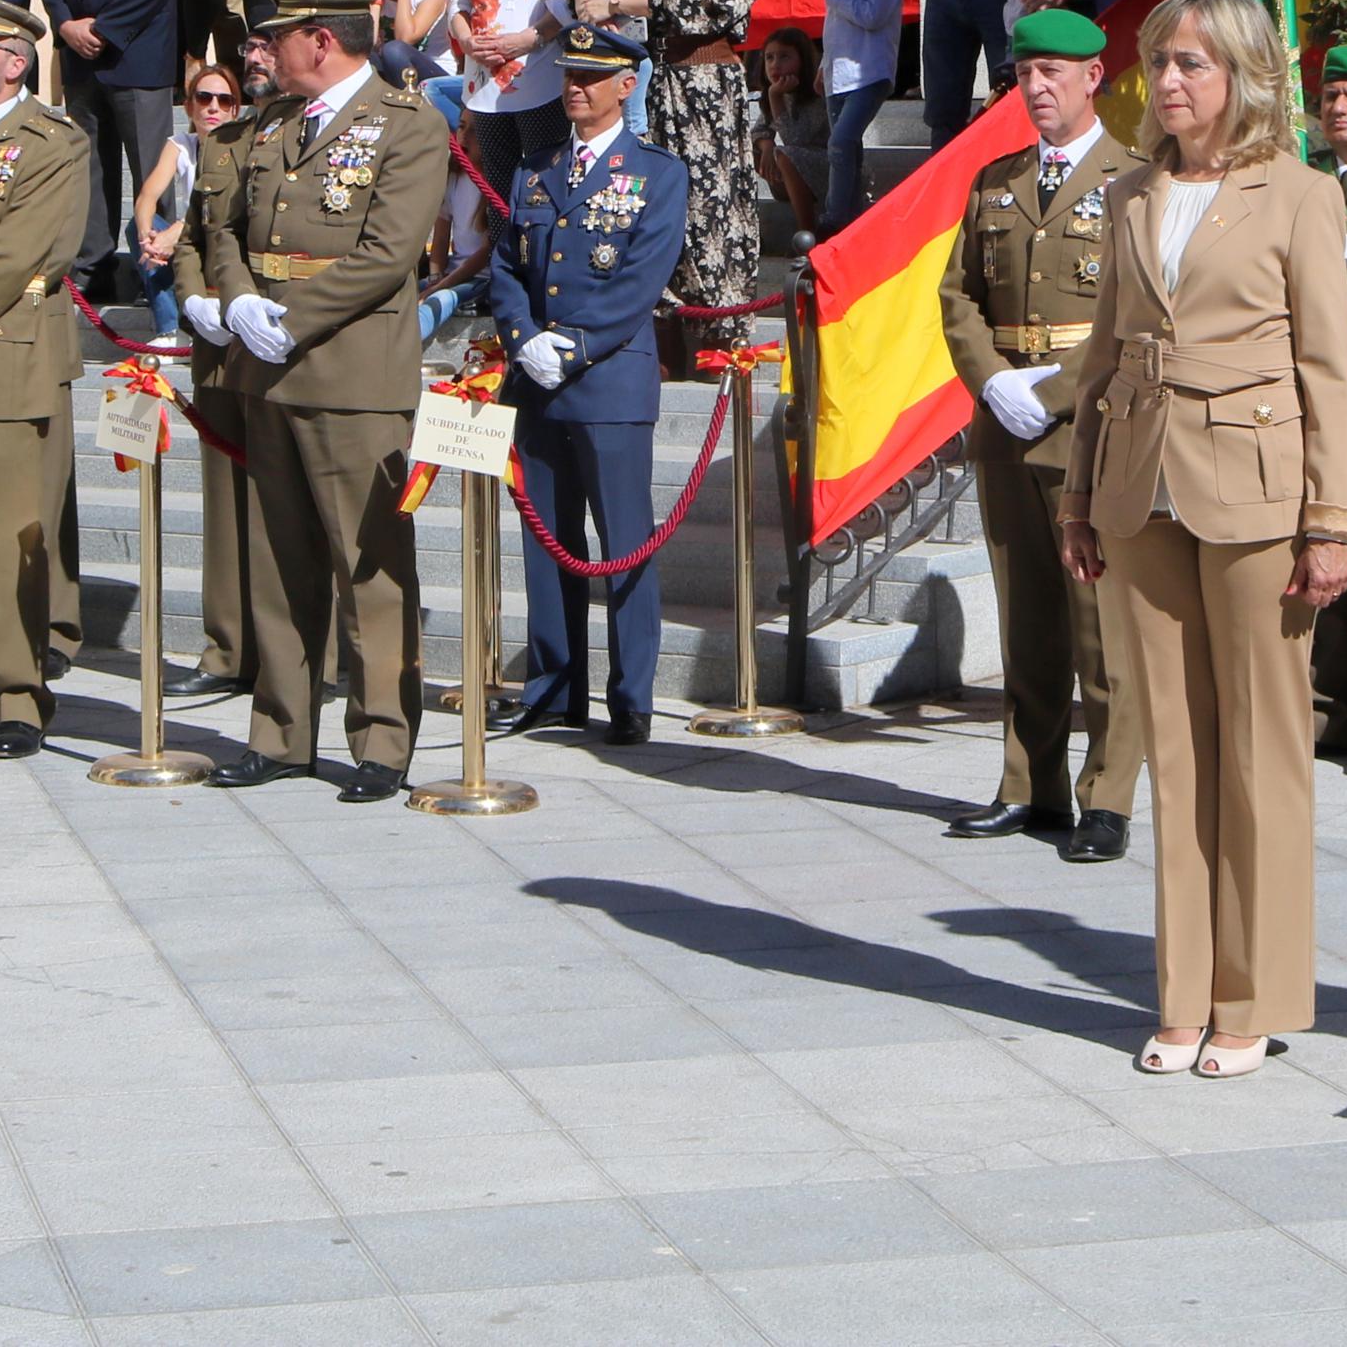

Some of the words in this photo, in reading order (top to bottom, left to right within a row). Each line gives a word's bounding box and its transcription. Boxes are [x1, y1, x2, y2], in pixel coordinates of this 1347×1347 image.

[106, 412, 152, 432] AUTORIDADES
[425, 416, 506, 440] SUBDELEGADO
[111, 426, 146, 443] MILITARES
[454, 435, 470, 445] DE
[437, 444, 485, 461] DEFENSA
